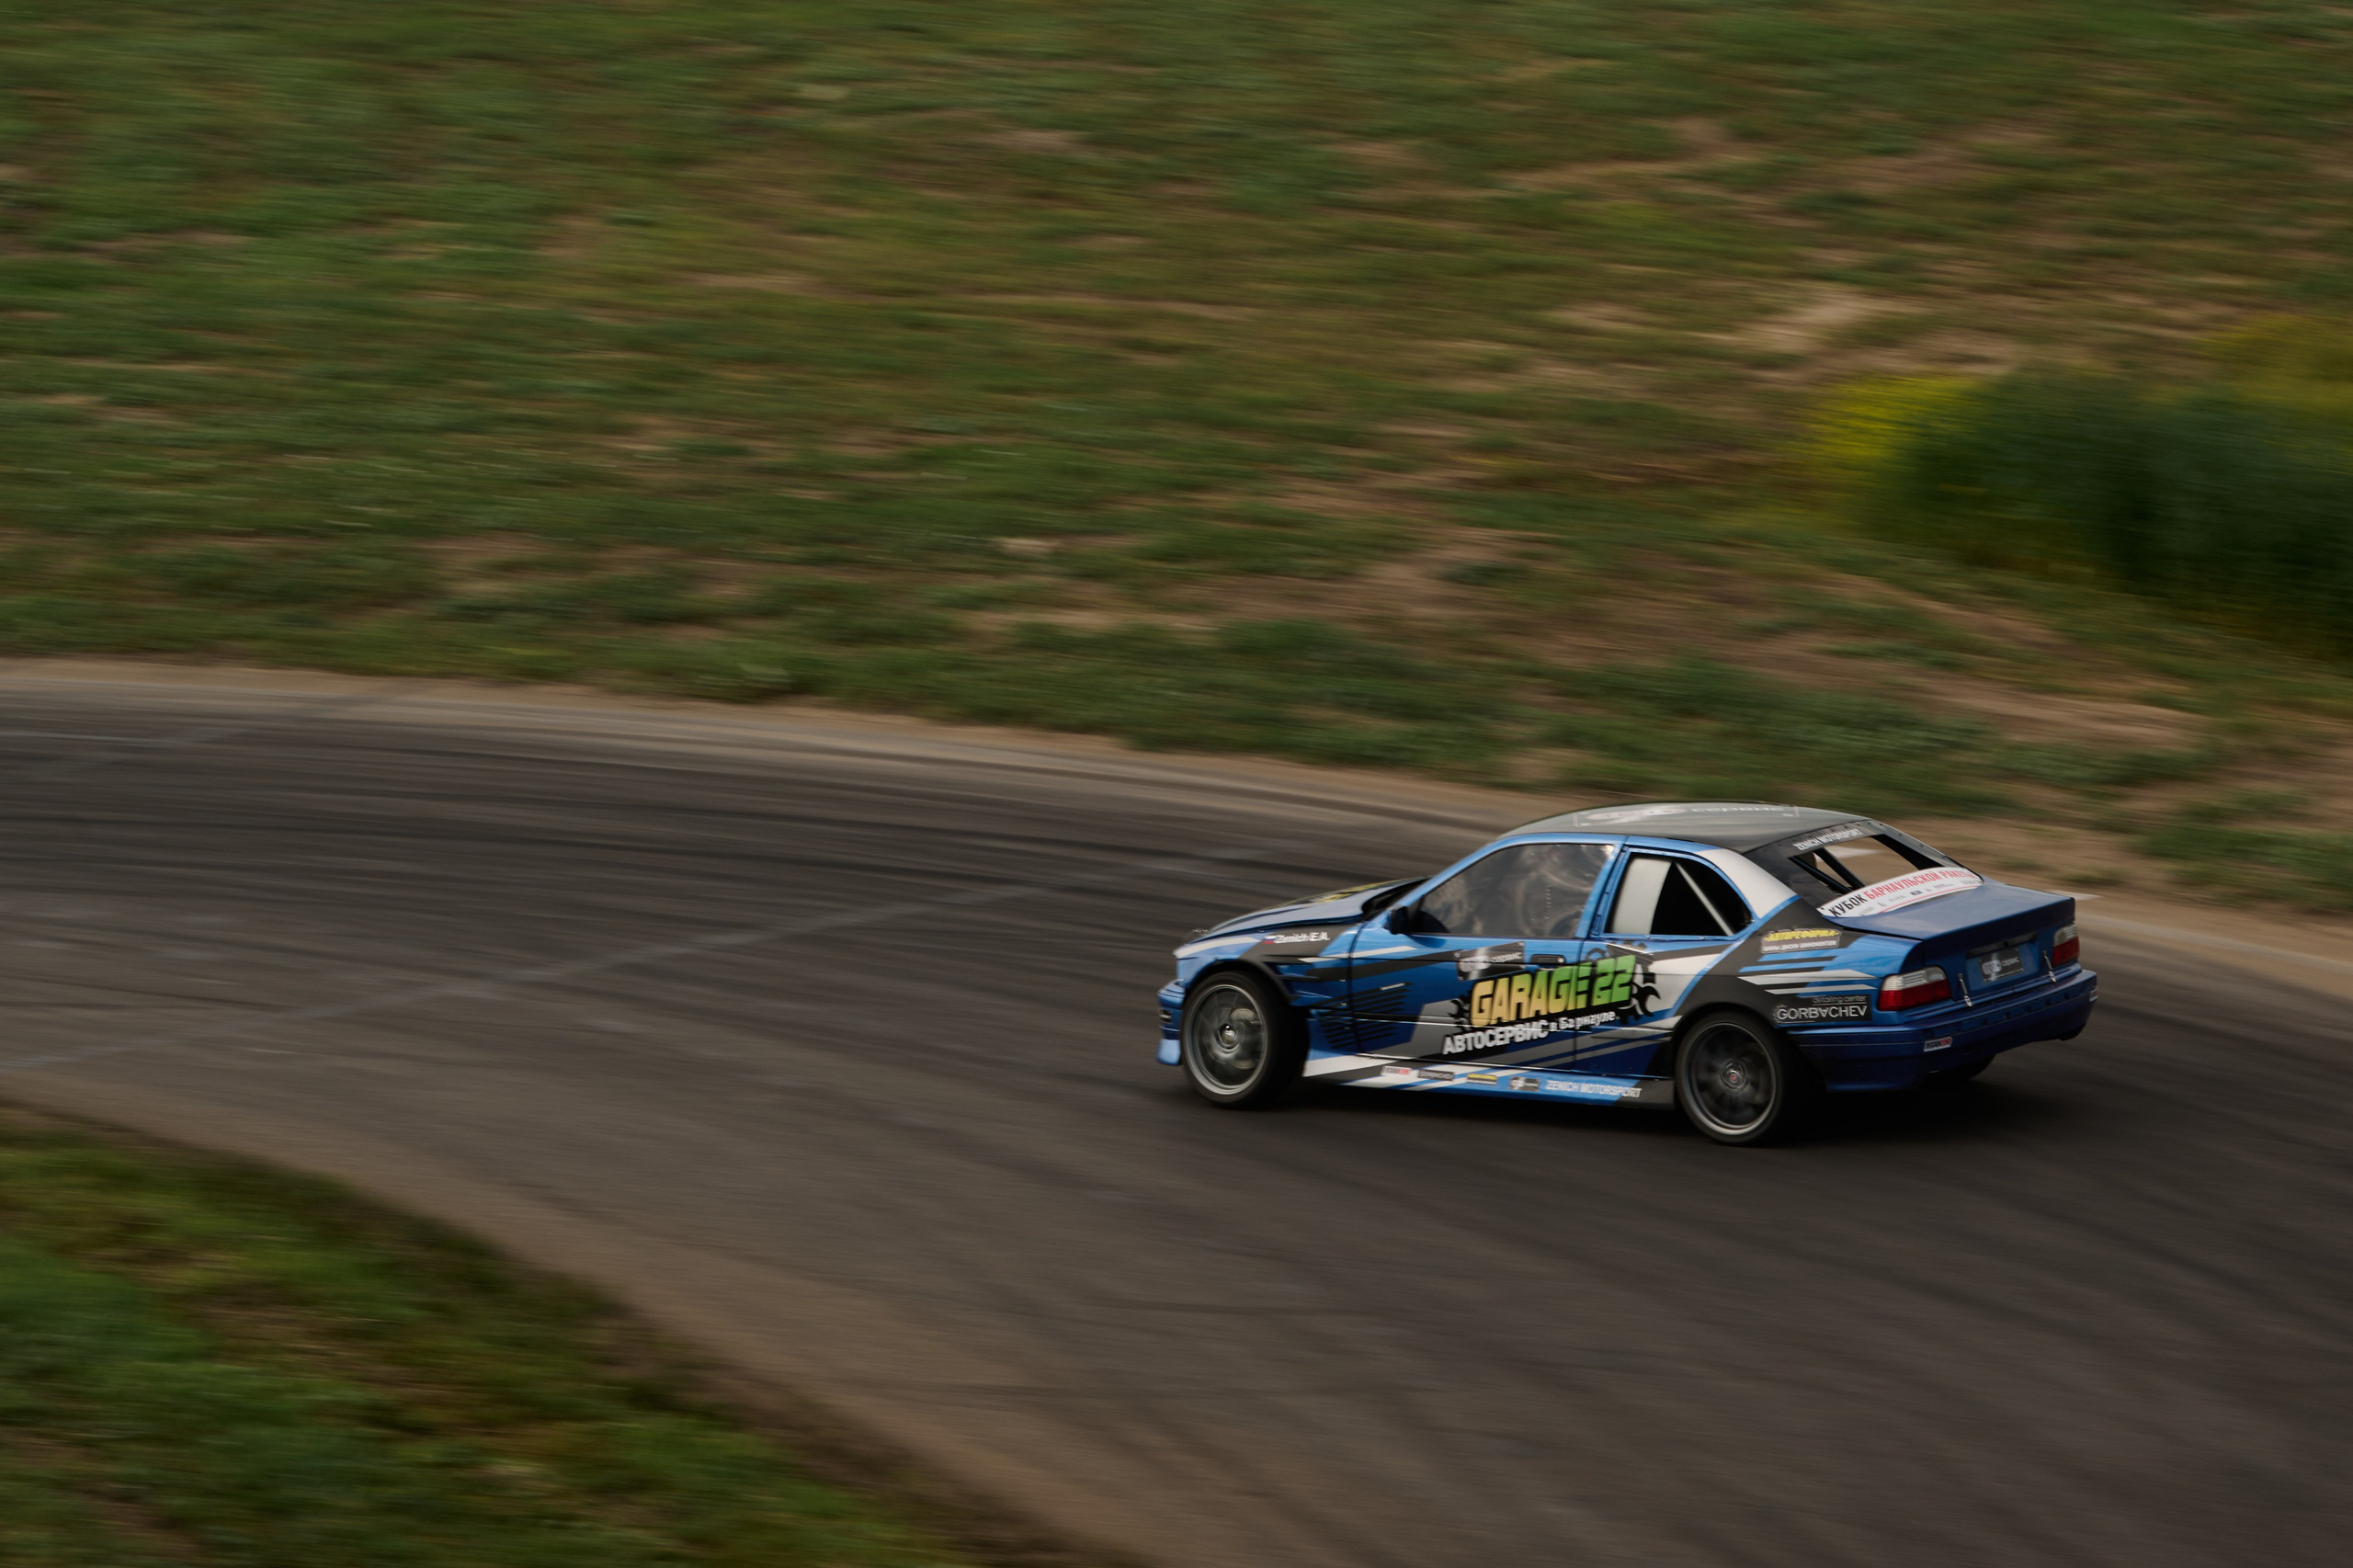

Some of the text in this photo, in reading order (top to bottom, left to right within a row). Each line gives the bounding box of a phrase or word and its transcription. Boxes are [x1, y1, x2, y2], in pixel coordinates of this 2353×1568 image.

[1828, 894, 1868, 917] КУБОК
[1864, 870, 1943, 900] БАРНАУЛЬСКОЙ
[1470, 954, 1636, 1028] GARAGE 22
[1442, 1010, 1616, 1055] АВТОСЕРВИС в Барнауле
[1544, 1079, 1579, 1093] ZENICH
[1579, 1083, 1643, 1098] MOTORSPORT
